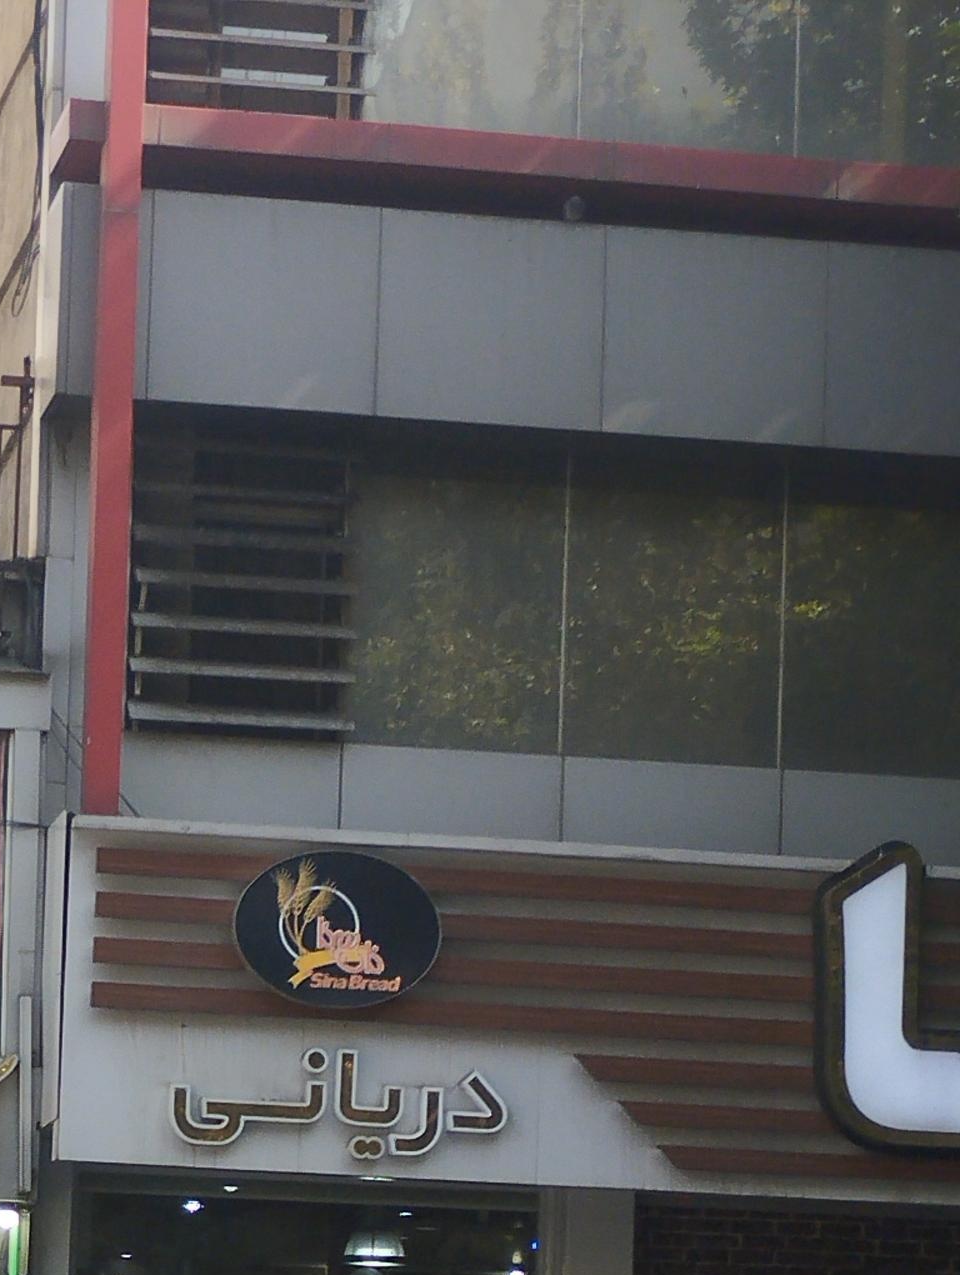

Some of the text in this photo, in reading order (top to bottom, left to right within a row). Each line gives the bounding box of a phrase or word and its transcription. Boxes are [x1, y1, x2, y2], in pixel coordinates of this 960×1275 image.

[310, 973, 401, 993] Sina Bread
[171, 1048, 509, 1160] دریانی
